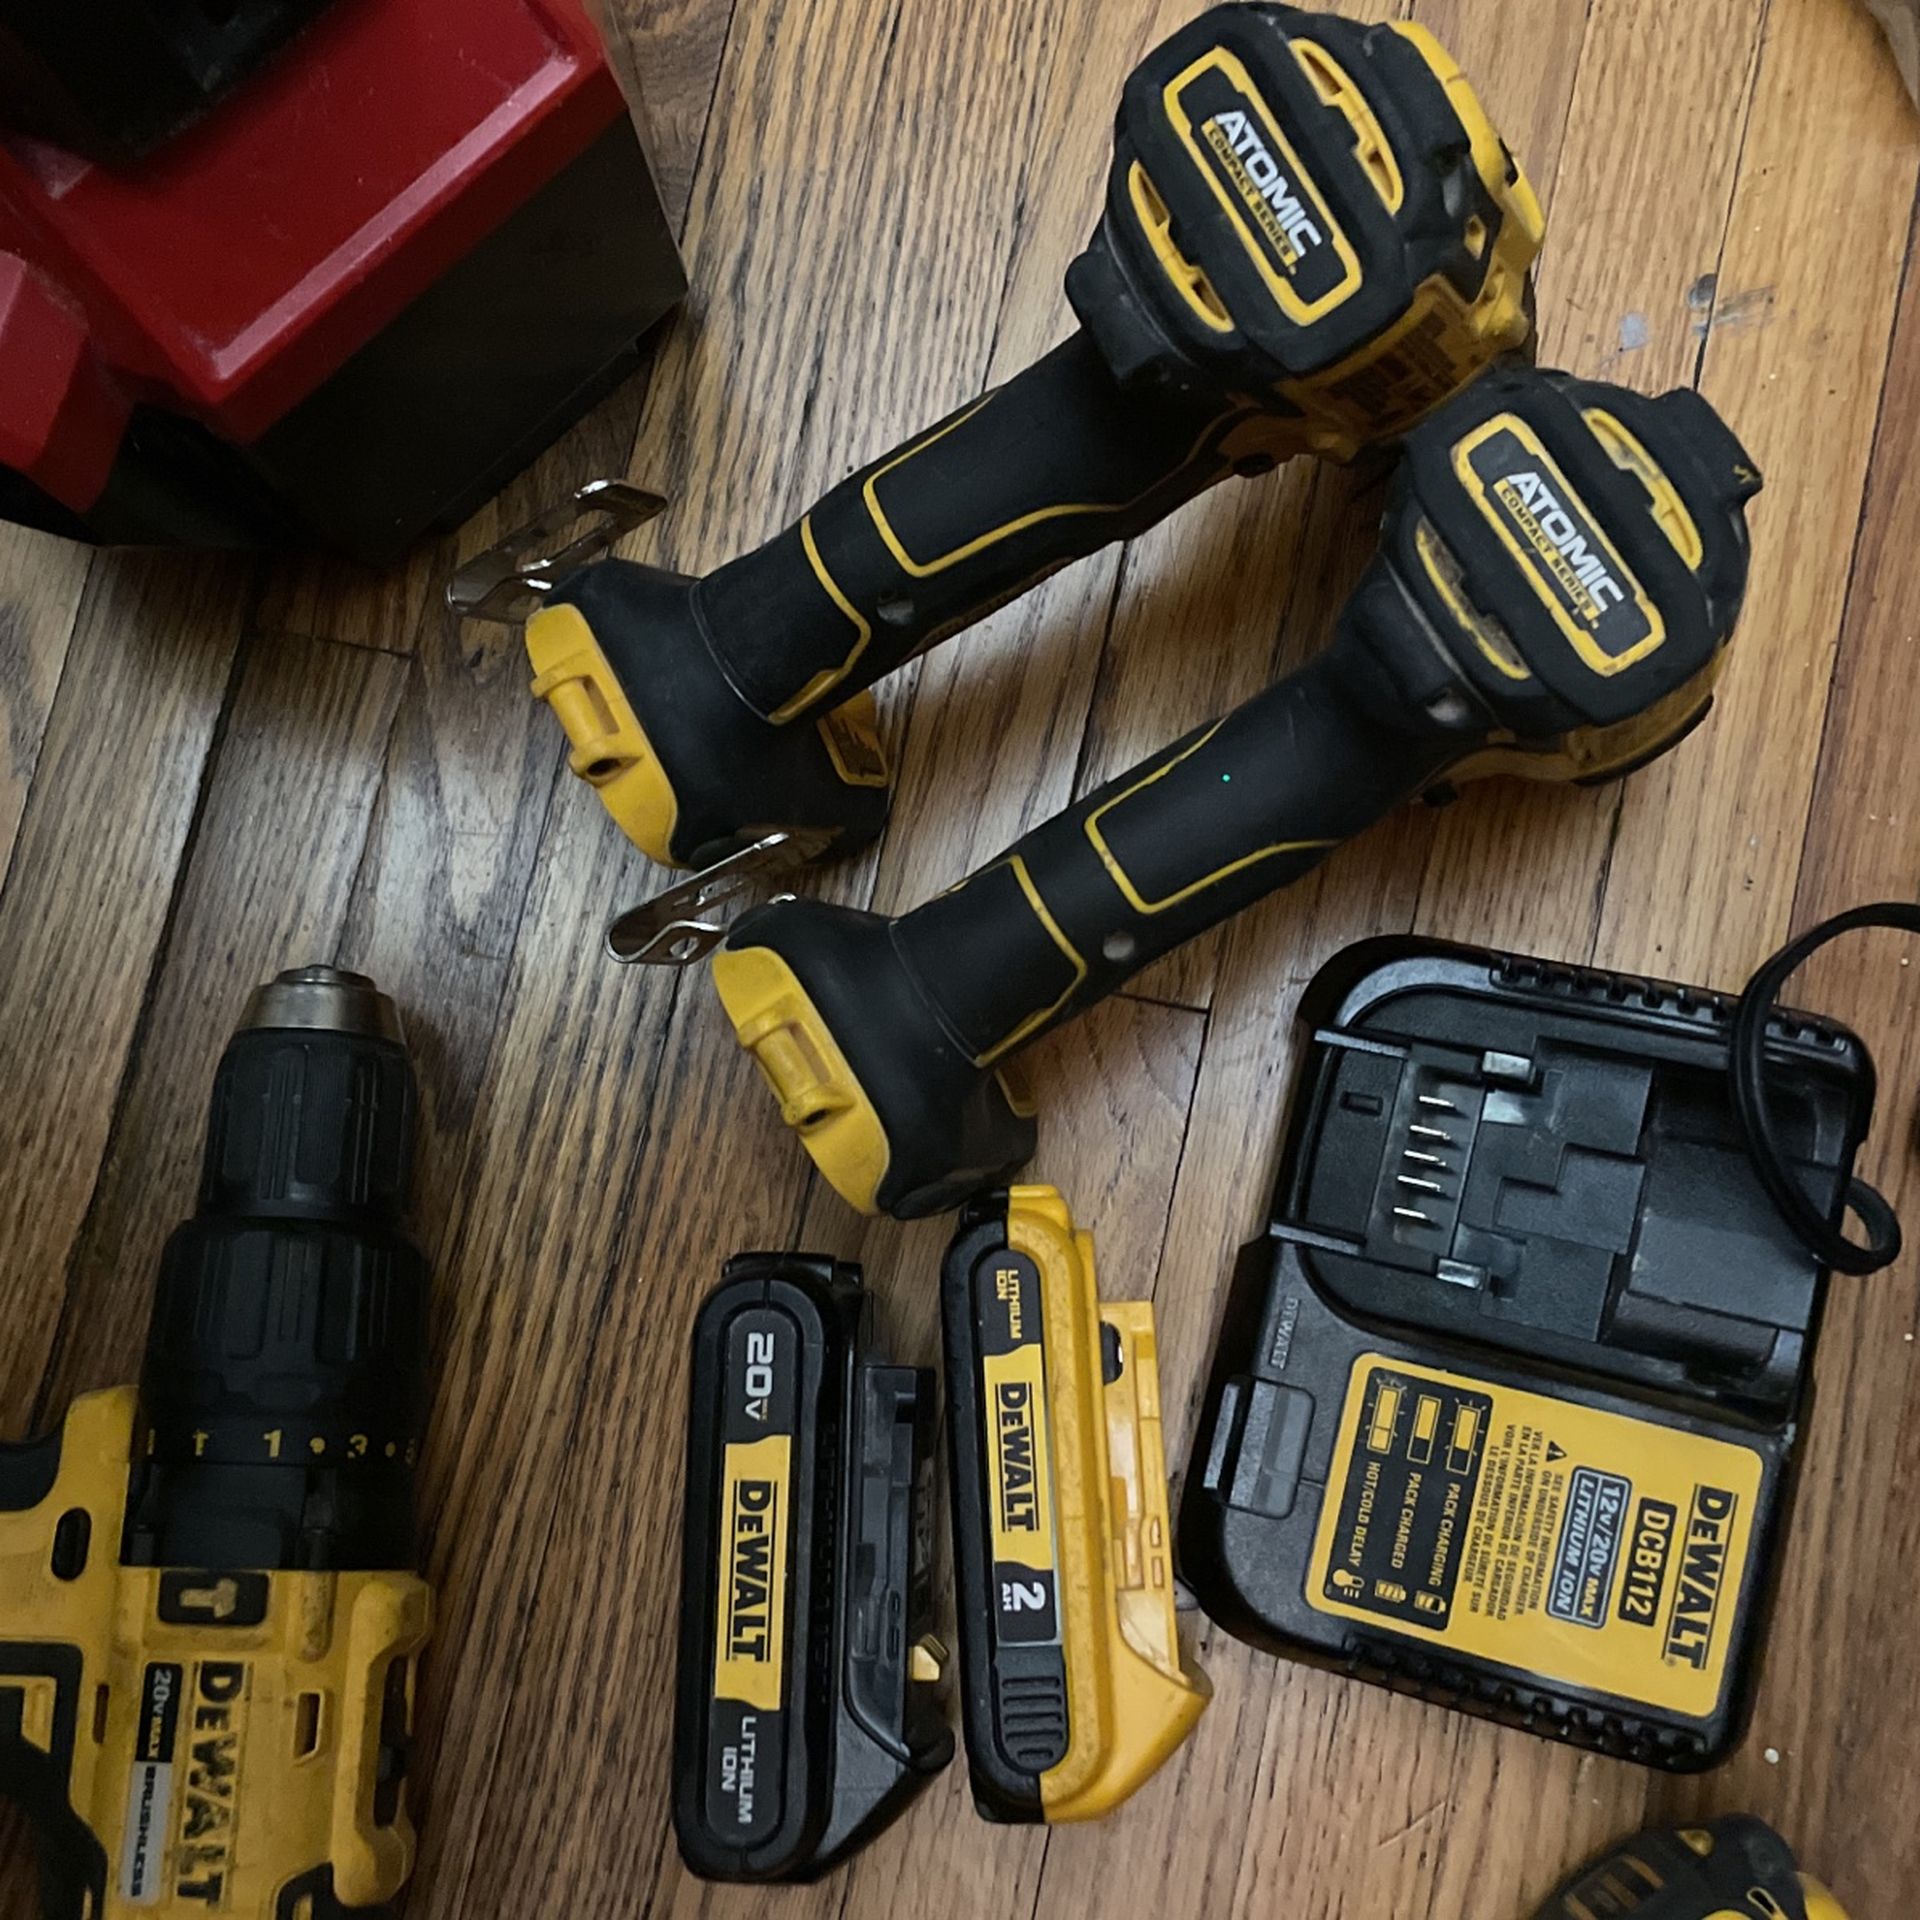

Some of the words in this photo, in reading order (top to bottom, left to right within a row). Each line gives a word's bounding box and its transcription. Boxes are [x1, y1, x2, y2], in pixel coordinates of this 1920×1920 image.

[1207, 129, 1255, 197] COMPACT
[1252, 195, 1291, 256] SERIES
[1215, 111, 1322, 257] ATOMIC
[1501, 488, 1551, 554] COMPACT
[1551, 557, 1592, 609] SERIES
[1506, 472, 1624, 612] ATOMIC
[995, 1269, 1008, 1301] ION
[1006, 1269, 1022, 1339] LITHIUM
[1001, 1381, 1034, 1532] DEWALT
[1488, 1444, 1499, 1457] LE
[1501, 1422, 1516, 1449] VOIR
[1517, 1442, 1528, 1457] LA
[1519, 1425, 1532, 1441] EN
[1530, 1429, 1543, 1451] VER
[1477, 1458, 1496, 1508] DESSOUS
[1510, 1457, 1525, 1490] PARTE
[1528, 1452, 1539, 1466] LA
[1539, 1469, 1551, 1487] ON
[1550, 1473, 1563, 1493] SEE
[1356, 1460, 1381, 1524] HOT/COLD
[1403, 1471, 1422, 1506] PACK
[1442, 1481, 1461, 1518] PACK
[1390, 1506, 1414, 1570] CHARGED
[1474, 1509, 1486, 1524] DE
[1499, 1492, 1518, 1541] INFERIOR
[1526, 1487, 1548, 1548] UNDERSIDE
[1542, 1494, 1559, 1534] SAFETY
[1563, 1477, 1595, 1566] LITHIUM
[1347, 1524, 1367, 1567] DELAY
[1427, 1517, 1454, 1587] CHARGING
[1462, 1524, 1483, 1583] CHARGEUR
[1482, 1532, 1493, 1547] DE
[1496, 1541, 1508, 1556] DE
[1508, 1543, 1520, 1557] DE
[1523, 1549, 1535, 1564] OF
[1623, 1507, 1670, 1617] DCB112
[732, 1480, 771, 1662] DEWALT
[1483, 1557, 1504, 1618] CARGADOR
[1495, 1558, 1517, 1622] SEGURIDAD
[1513, 1564, 1532, 1617] CHARGER
[1526, 1534, 1551, 1610] INFORMATION
[1554, 1569, 1577, 1612] ION
[1665, 1485, 1735, 1670] DEWALT
[1009, 1579, 1045, 1612] 2
[1468, 1590, 1482, 1614] SUR
[1579, 1575, 1599, 1617] MAX
[719, 1744, 738, 1792] ION
[735, 1714, 758, 1824] LITHIUM
[131, 1765, 157, 1898] BRUSHLESS
